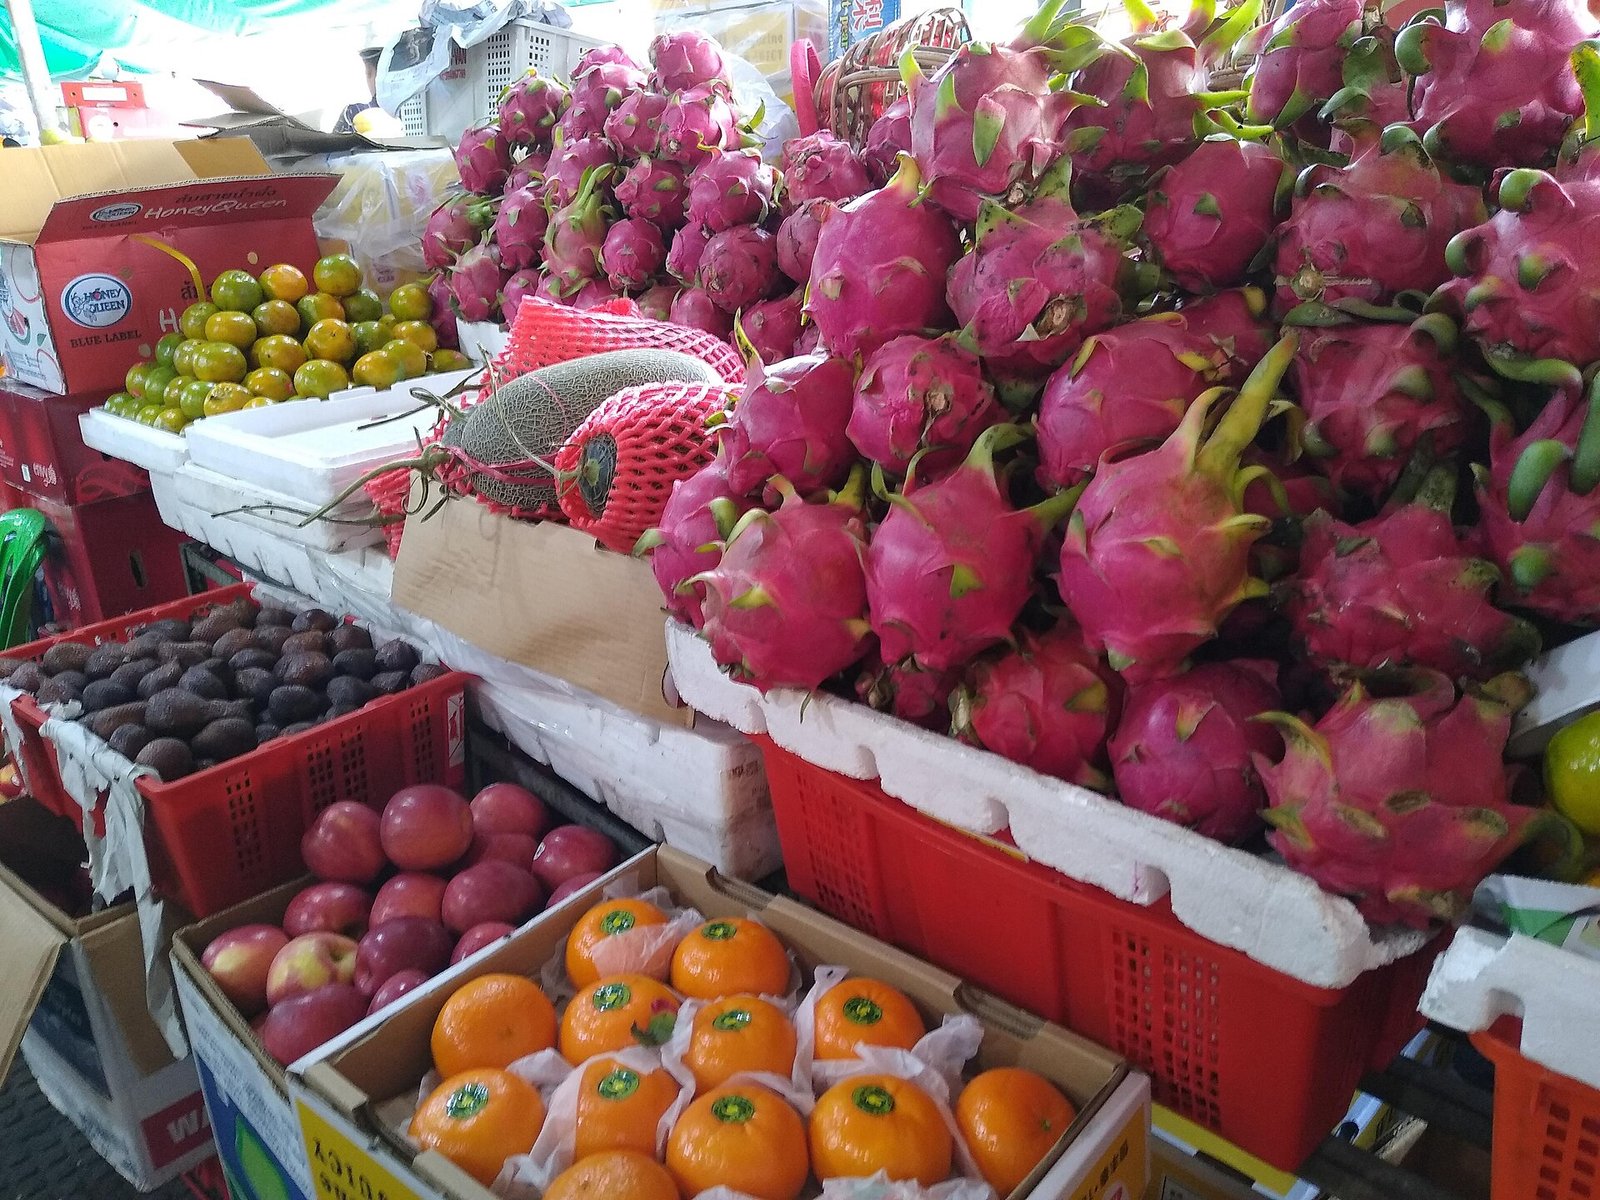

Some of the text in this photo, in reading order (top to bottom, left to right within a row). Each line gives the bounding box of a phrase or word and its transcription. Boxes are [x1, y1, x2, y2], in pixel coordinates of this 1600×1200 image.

[144, 199, 287, 219] HoneyQueen
[84, 287, 123, 302] HONEY
[89, 300, 125, 314] QUEEN
[159, 307, 183, 333] H
[70, 330, 142, 348] BLUE LABEL
